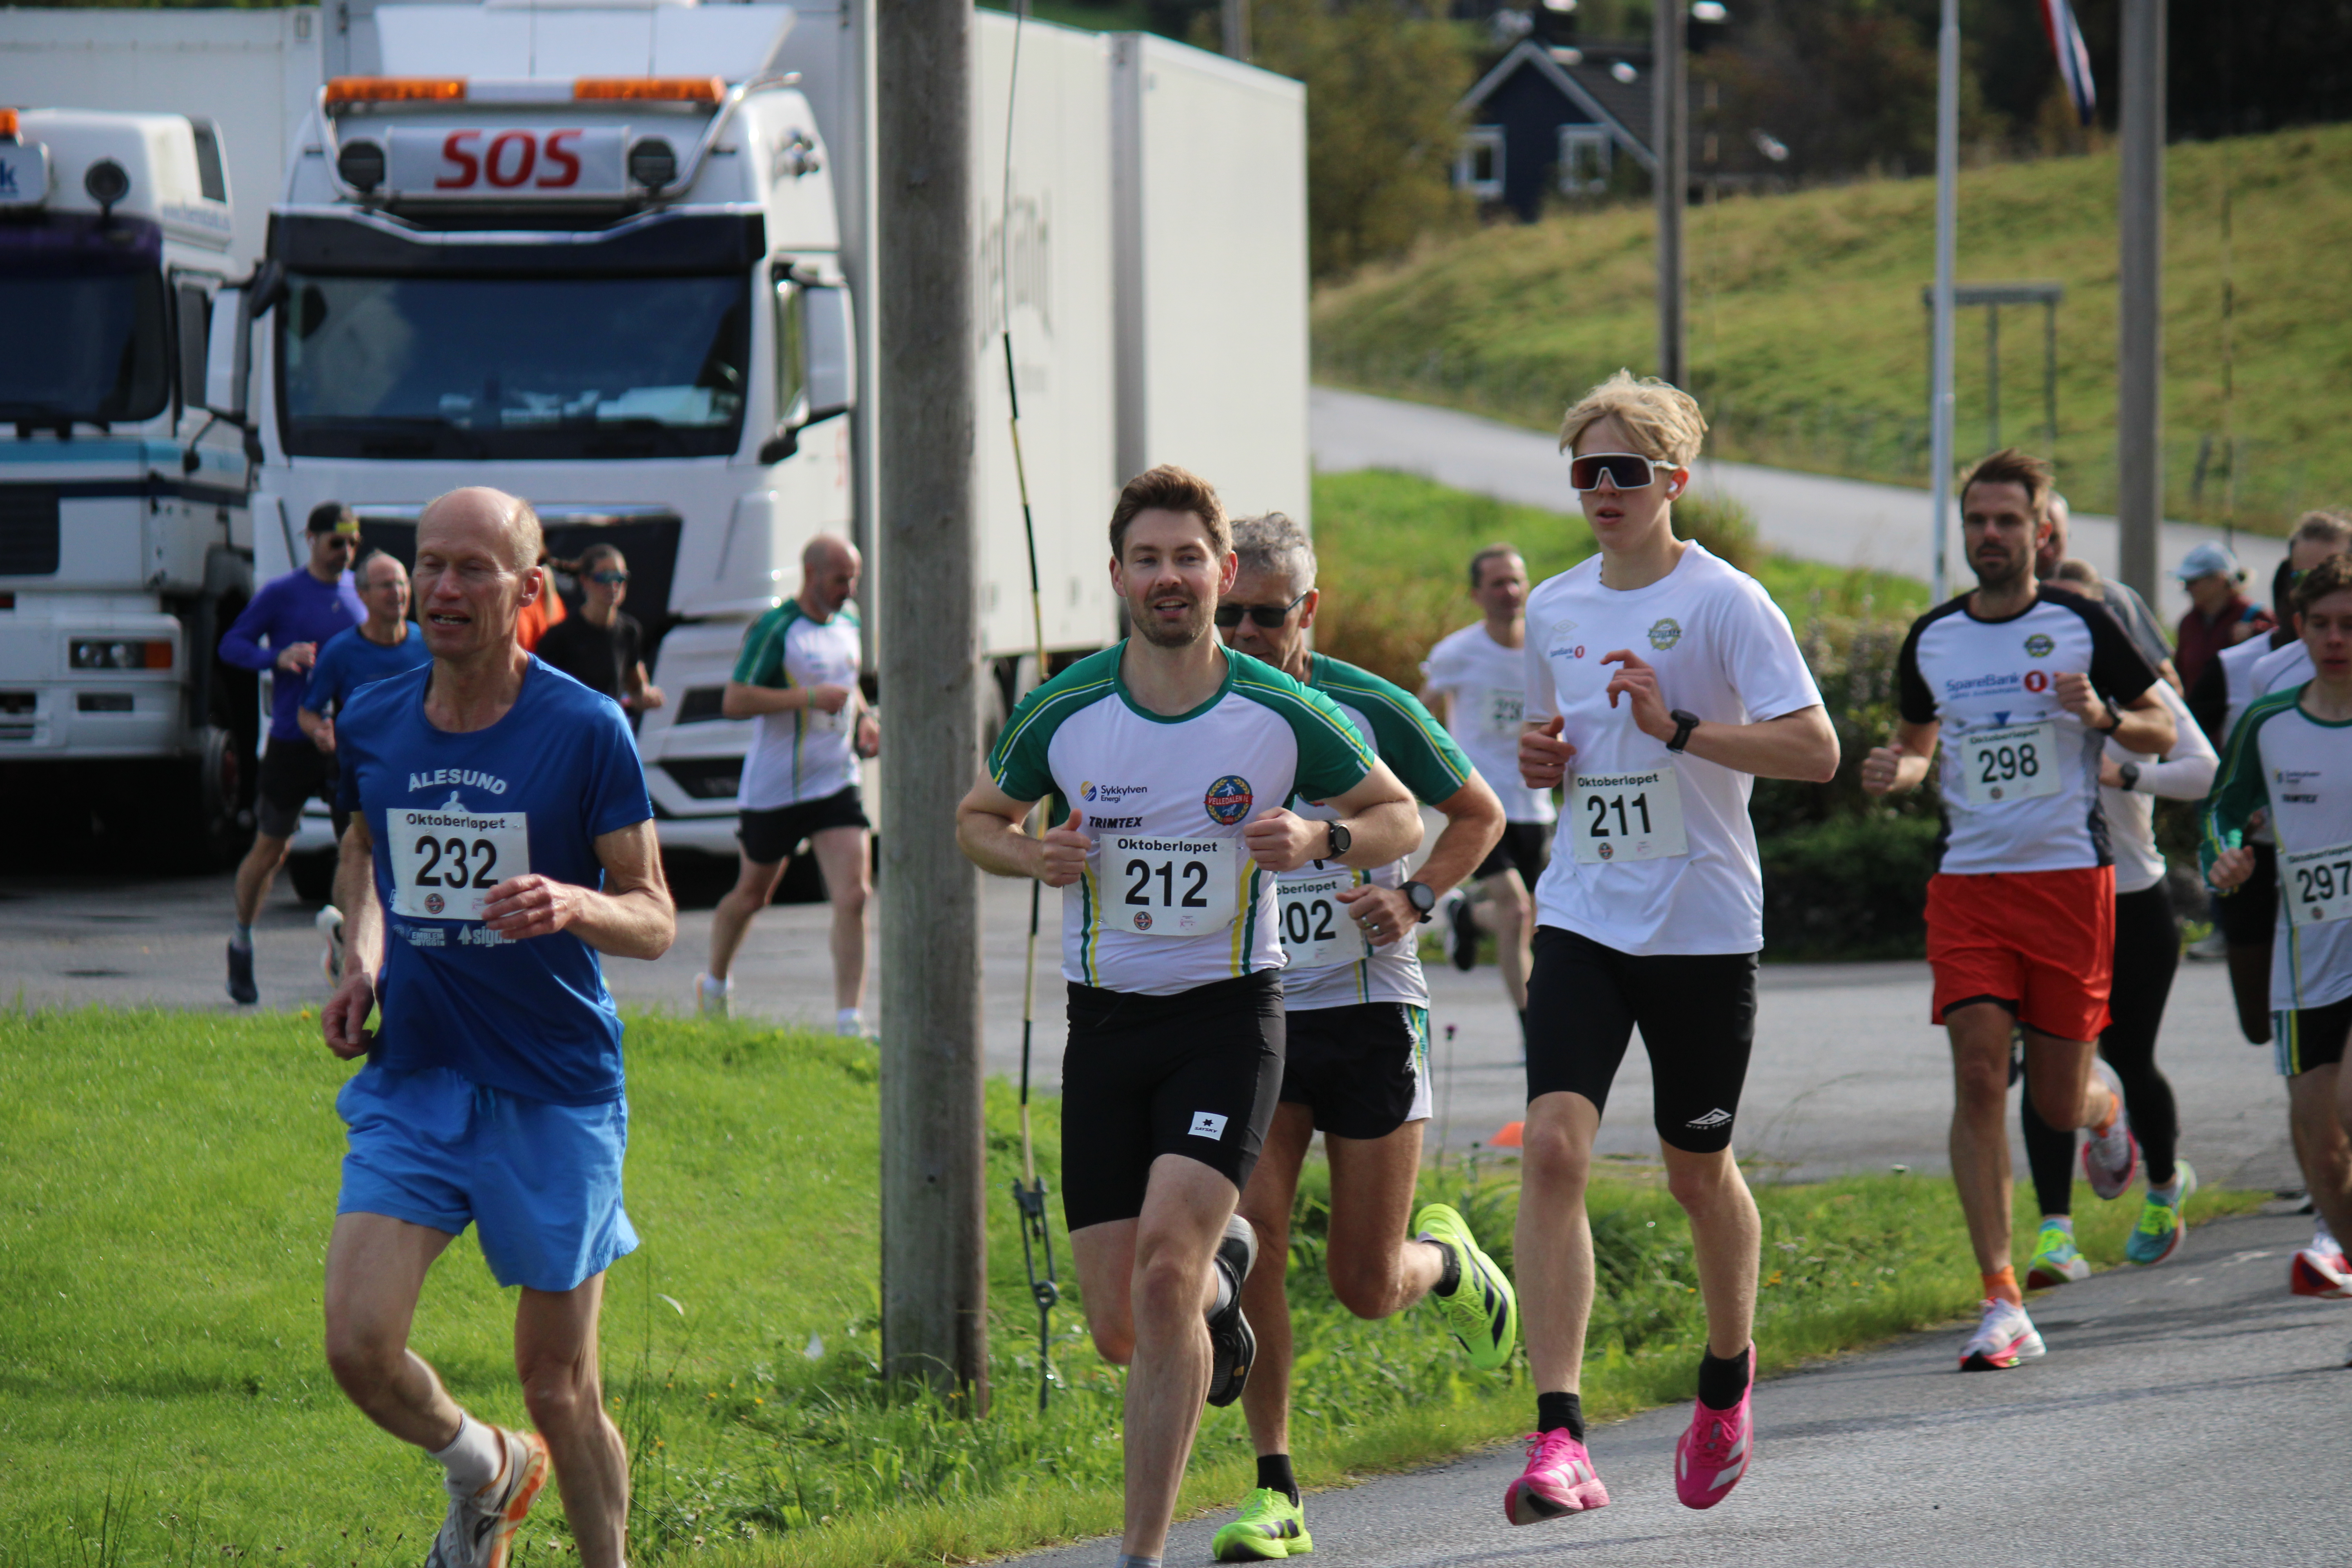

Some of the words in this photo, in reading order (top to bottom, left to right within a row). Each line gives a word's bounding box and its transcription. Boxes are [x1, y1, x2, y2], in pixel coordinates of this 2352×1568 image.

[434, 128, 583, 188] SOS
[1946, 672, 2020, 693] SpareBank
[1978, 743, 2039, 783] 298
[1577, 773, 1659, 787] Oktoberløpet
[1101, 785, 1147, 795] Sykkylven
[1101, 795, 1120, 803] Energi
[1208, 795, 1243, 805] VELLEDALEN
[406, 813, 505, 832] Oktoberløpet
[1089, 816, 1143, 828] TRIMTEX
[1588, 793, 1651, 837] 211
[1118, 838, 1217, 854] Oktoberløpet
[415, 835, 499, 889] 232
[1125, 859, 1208, 907] 212
[1277, 880, 1337, 895] oberløpet
[2298, 860, 2351, 903] 297
[412, 931, 444, 940] EMBLEM
